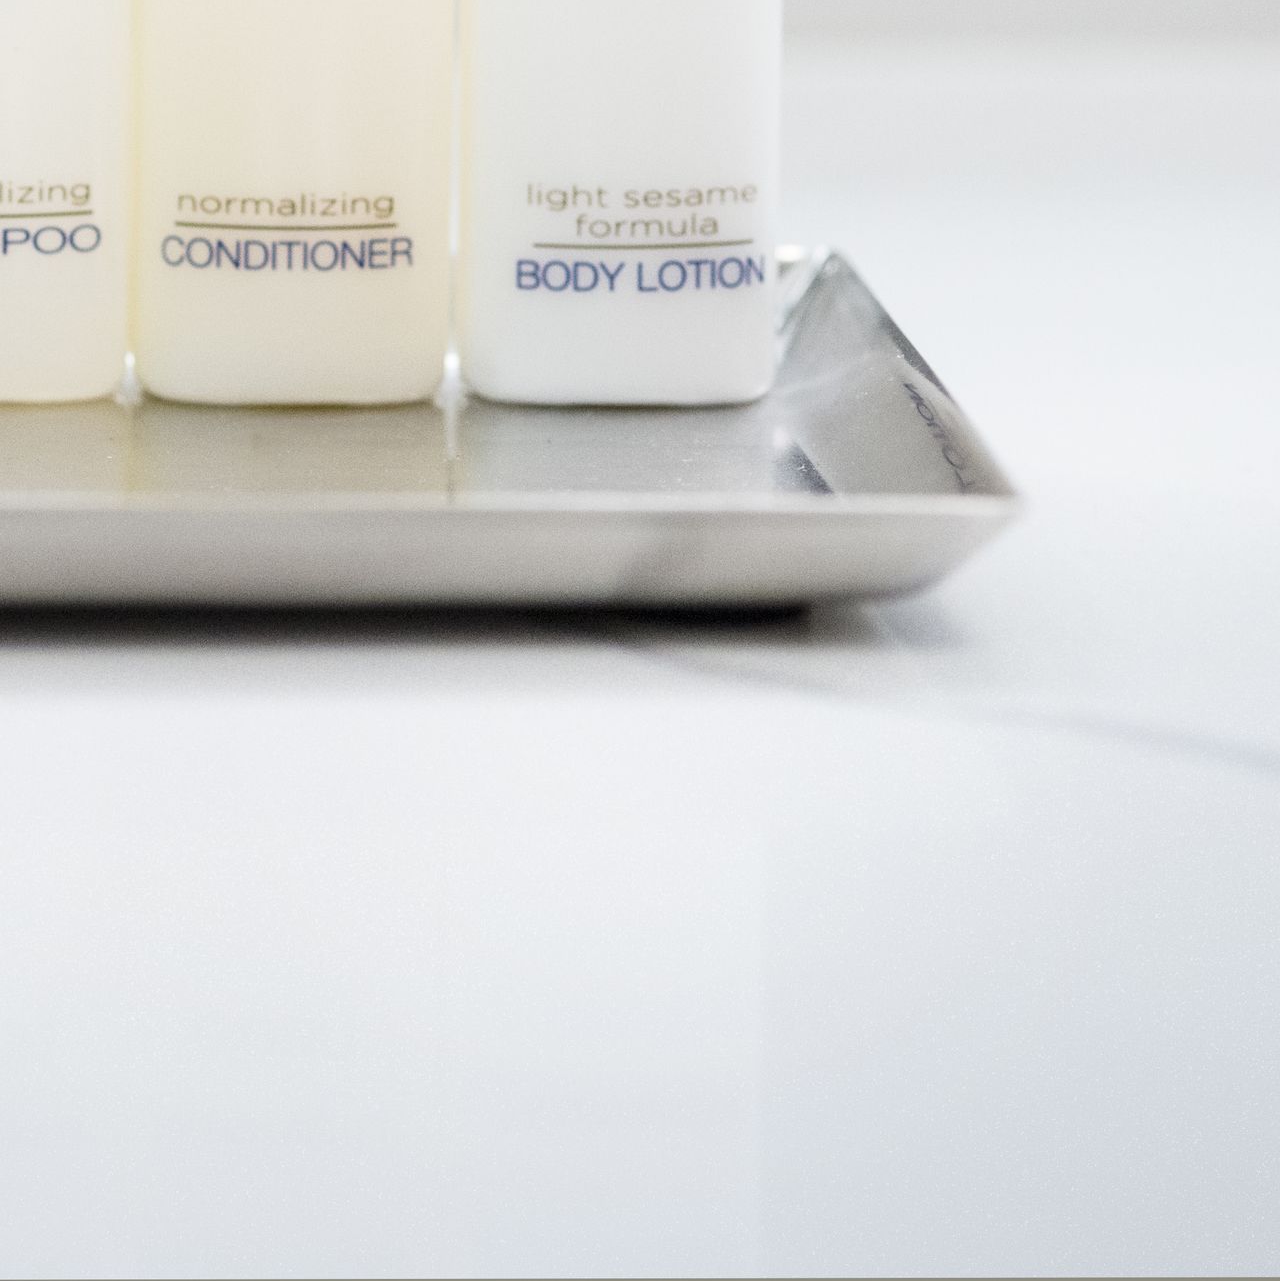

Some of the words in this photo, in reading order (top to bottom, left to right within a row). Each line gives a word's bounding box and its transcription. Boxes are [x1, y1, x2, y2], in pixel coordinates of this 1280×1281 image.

[176, 190, 397, 222] normalizing
[526, 182, 608, 212] light
[623, 184, 758, 209] sesame
[574, 212, 720, 240] formula
[161, 234, 415, 272] CONDITIONER
[514, 258, 627, 293] BODY
[635, 255, 766, 293] LOTION
